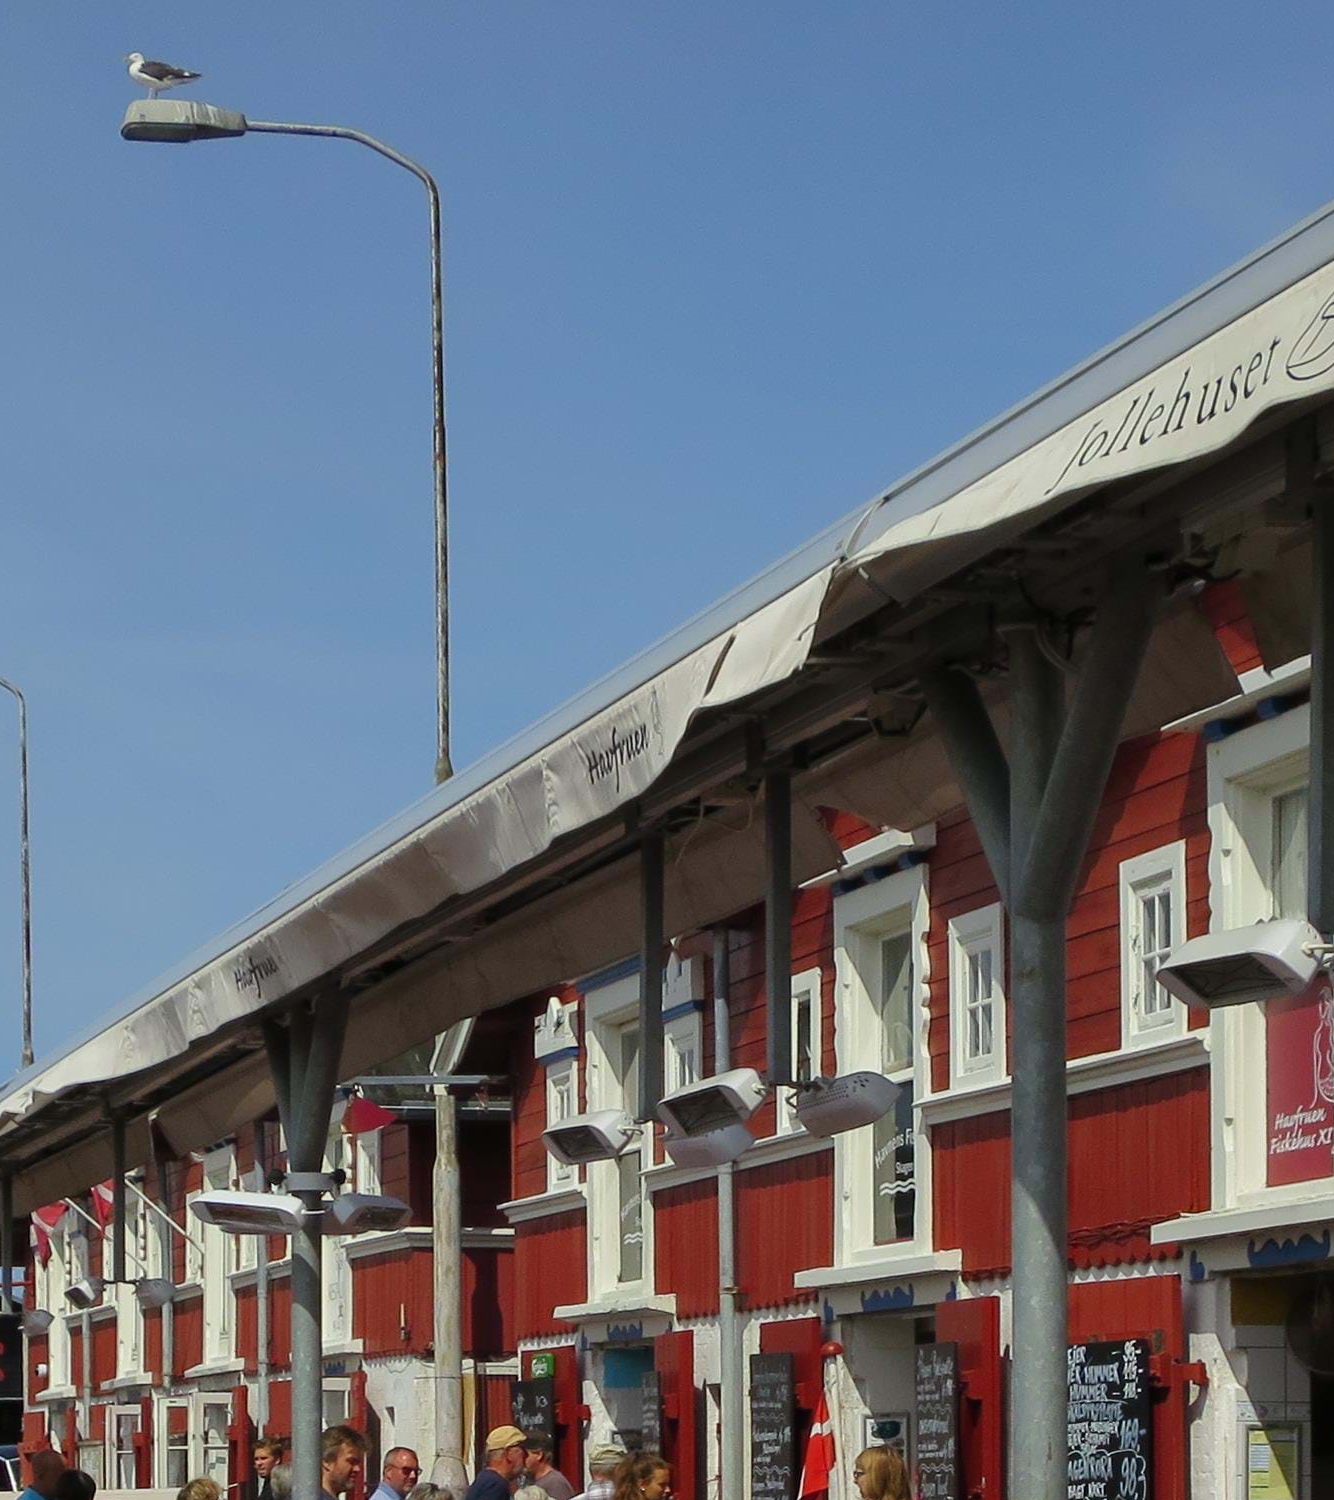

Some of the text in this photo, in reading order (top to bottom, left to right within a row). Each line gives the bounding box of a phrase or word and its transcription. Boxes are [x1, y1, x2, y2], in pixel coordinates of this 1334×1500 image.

[587, 724, 650, 793] Havfruen
[1274, 1105, 1327, 1137] Havfruen
[1270, 1128, 1317, 1154] Fiskehus
